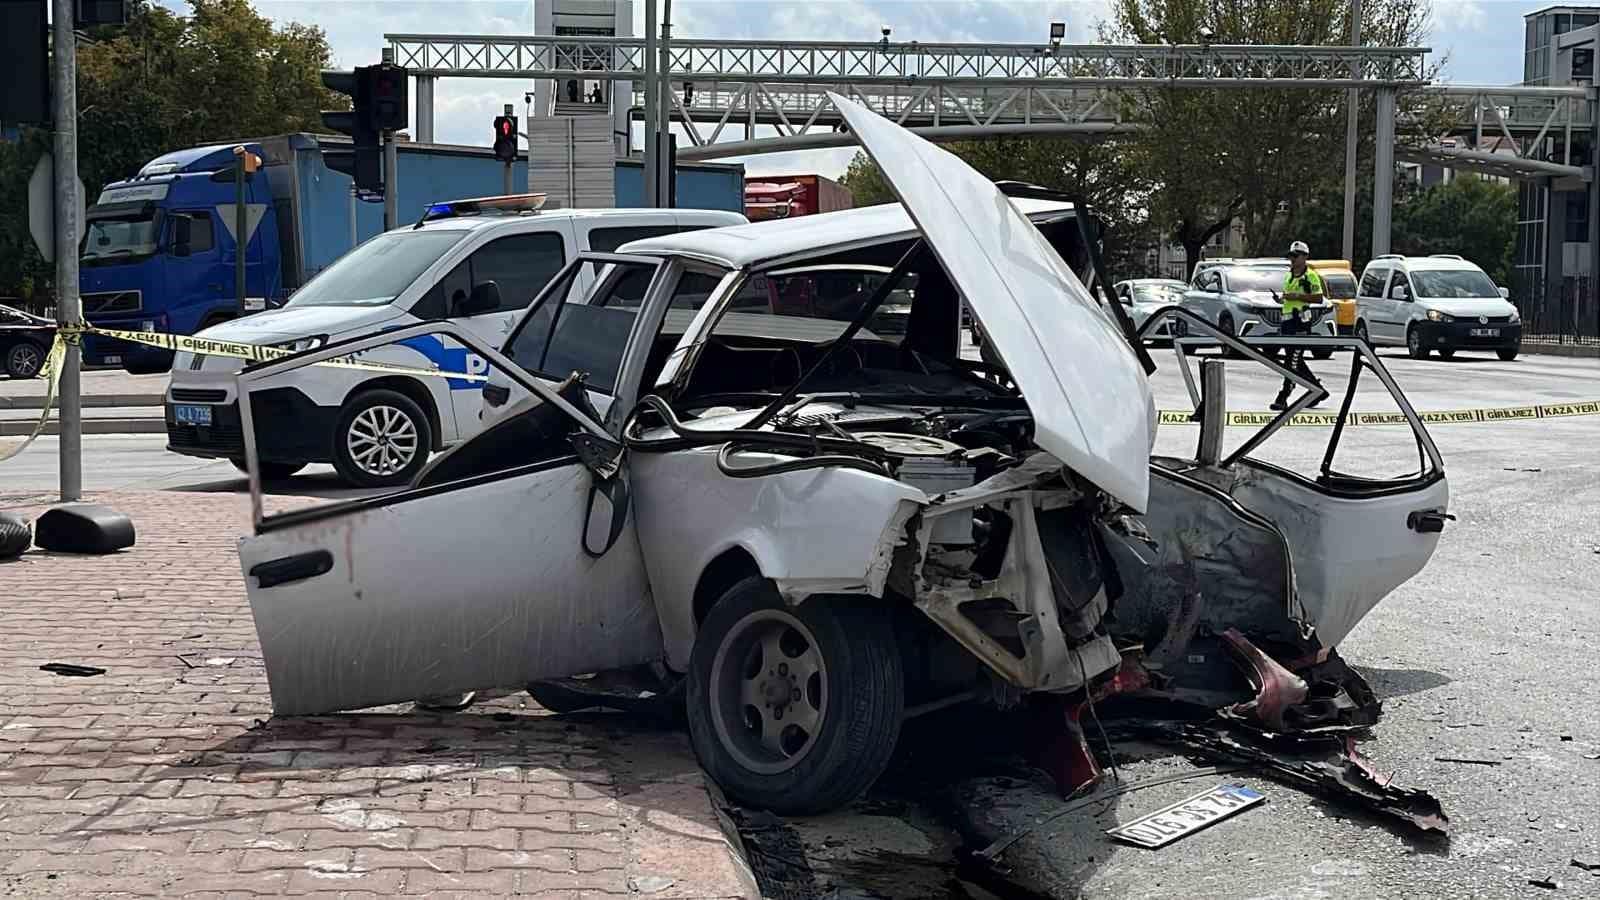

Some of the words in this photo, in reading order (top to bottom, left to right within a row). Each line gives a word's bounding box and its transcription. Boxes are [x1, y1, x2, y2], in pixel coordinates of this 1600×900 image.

[1293, 415, 1321, 424] KAZA
[1361, 413, 1408, 424] GİRİLMEZ
[1488, 408, 1534, 419] GİRİLMEZ
[1544, 406, 1574, 416] KAZA
[1126, 817, 1188, 841] 970
